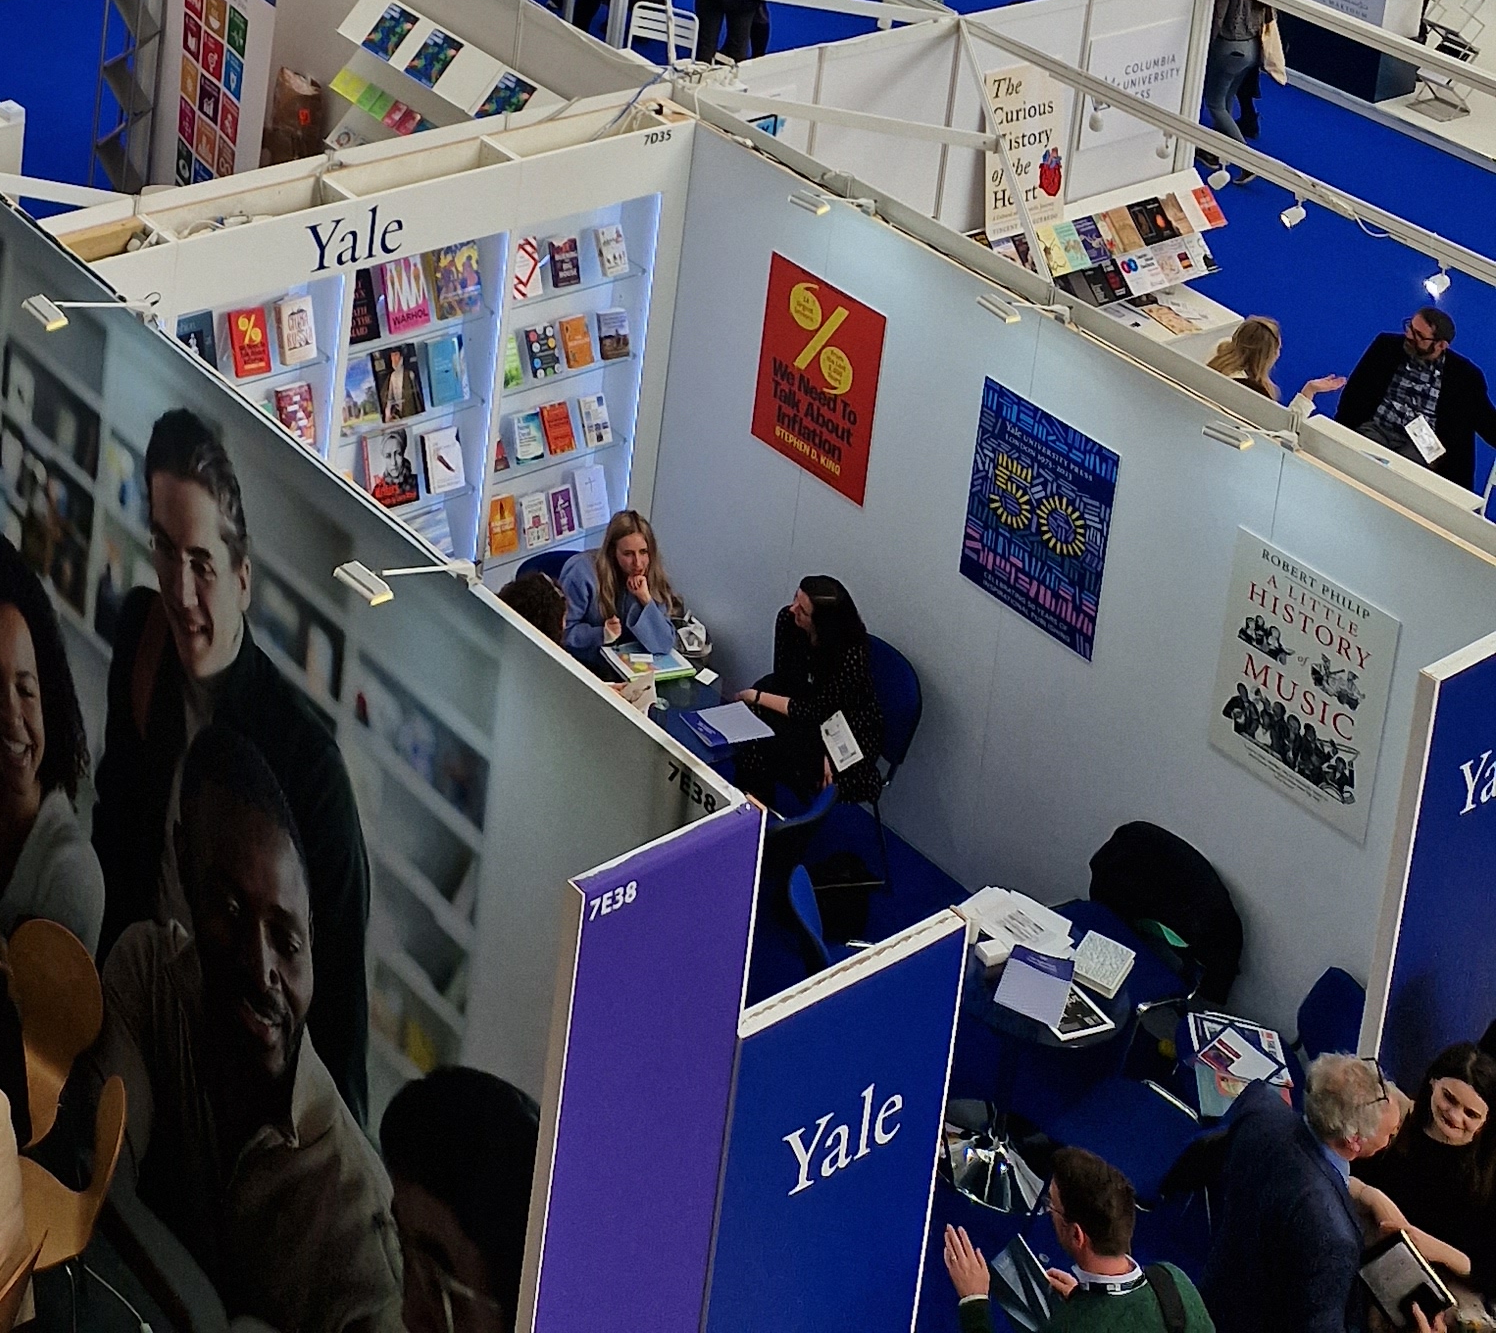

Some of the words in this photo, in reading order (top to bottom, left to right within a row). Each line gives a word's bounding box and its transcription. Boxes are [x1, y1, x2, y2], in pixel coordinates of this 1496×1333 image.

[992, 77, 1023, 100] The
[1122, 67, 1181, 90] UNIVERSITY
[1124, 54, 1176, 76] COLUMBIA
[644, 130, 673, 147] 7D35
[993, 100, 1054, 126] Curious
[1012, 158, 1032, 177] he
[992, 184, 1038, 211] Hert
[305, 205, 404, 274] Yale
[392, 309, 430, 327] WARHOL
[772, 356, 796, 383] We
[797, 372, 838, 414] Need
[840, 396, 858, 426] To
[772, 380, 801, 414] Talk
[804, 401, 854, 447] About
[775, 425, 810, 457] STEPHEN
[810, 445, 819, 462] D.
[820, 454, 841, 477] KING
[776, 404, 843, 463] Inflation
[1005, 432, 1036, 457] LONDON
[1006, 420, 1023, 438] Yale
[1023, 433, 1069, 467] UNIVERSITY
[1069, 462, 1094, 482] PRESS
[989, 451, 1086, 558] 50
[982, 578, 1030, 617] INSPIRATIONAL
[1030, 610, 1071, 644] PUBLISHING
[983, 570, 1027, 605] CELEBRATING
[1036, 605, 1059, 627] YEARS
[1058, 620, 1068, 632] OF
[1261, 547, 1317, 589] ROBERT
[1321, 582, 1371, 620] PHILIP
[1266, 573, 1279, 590] A
[1288, 584, 1359, 638] LITTLE
[1247, 580, 1373, 671] HISTORY
[1297, 654, 1311, 667] of
[1241, 652, 1355, 742] MUSIC
[667, 760, 719, 815] 7E38
[589, 881, 638, 922] 7E38
[782, 1084, 904, 1197] Yale
